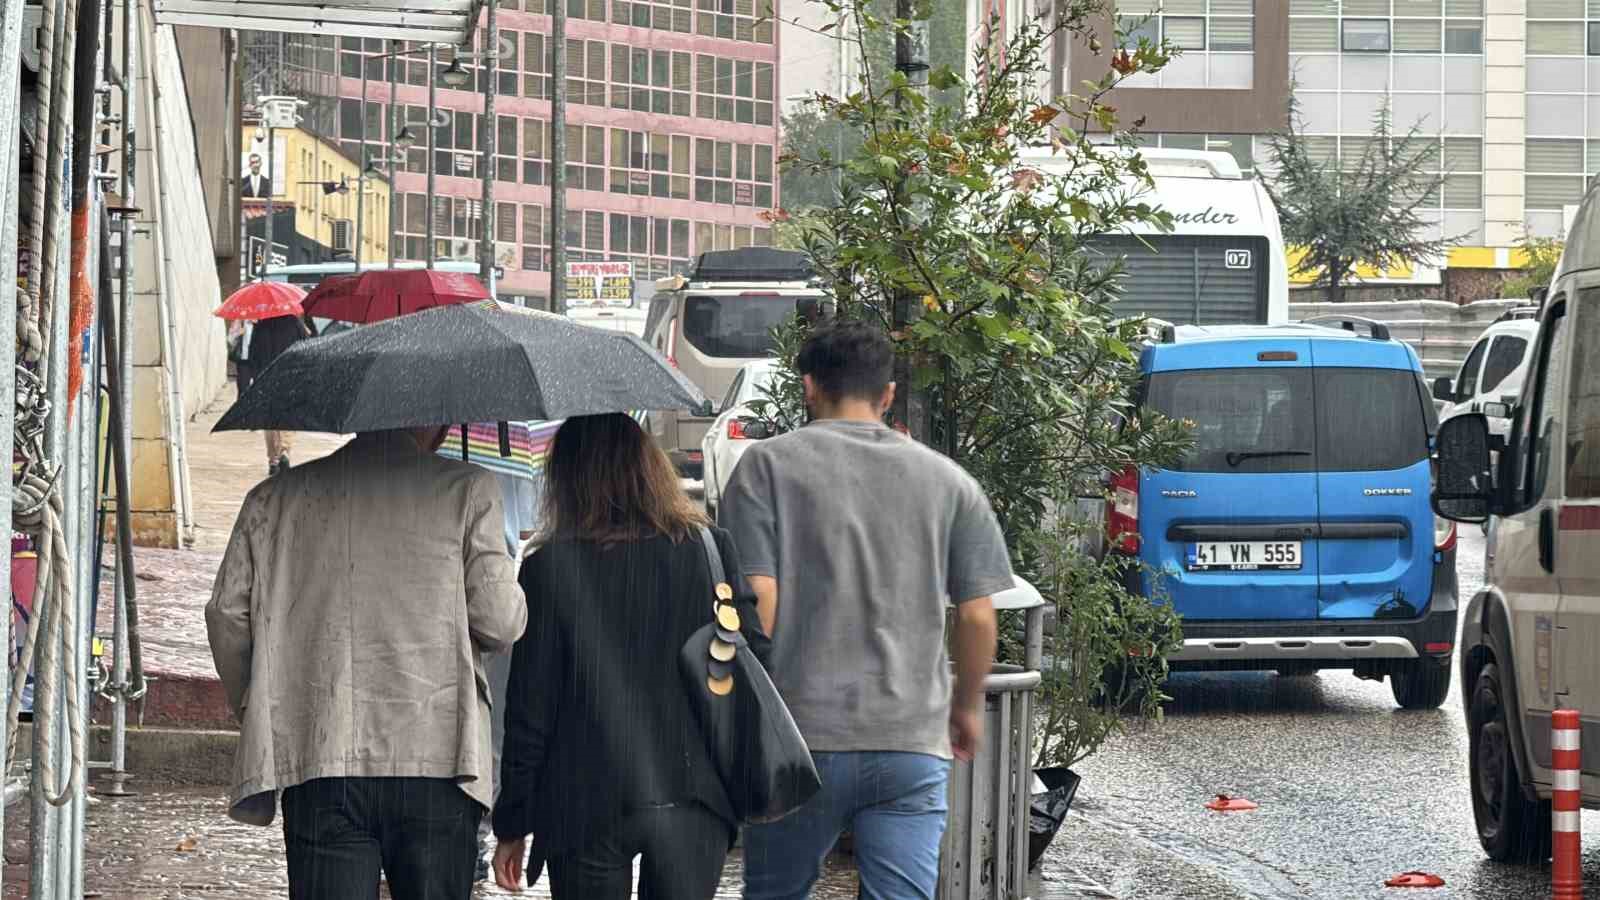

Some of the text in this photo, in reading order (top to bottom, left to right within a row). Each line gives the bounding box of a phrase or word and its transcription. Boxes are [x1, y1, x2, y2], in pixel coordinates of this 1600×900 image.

[1174, 206, 1239, 224] nder
[1228, 252, 1248, 265] 07
[1363, 488, 1412, 497] DOKKER
[1197, 543, 1296, 562] 41 VN 555
